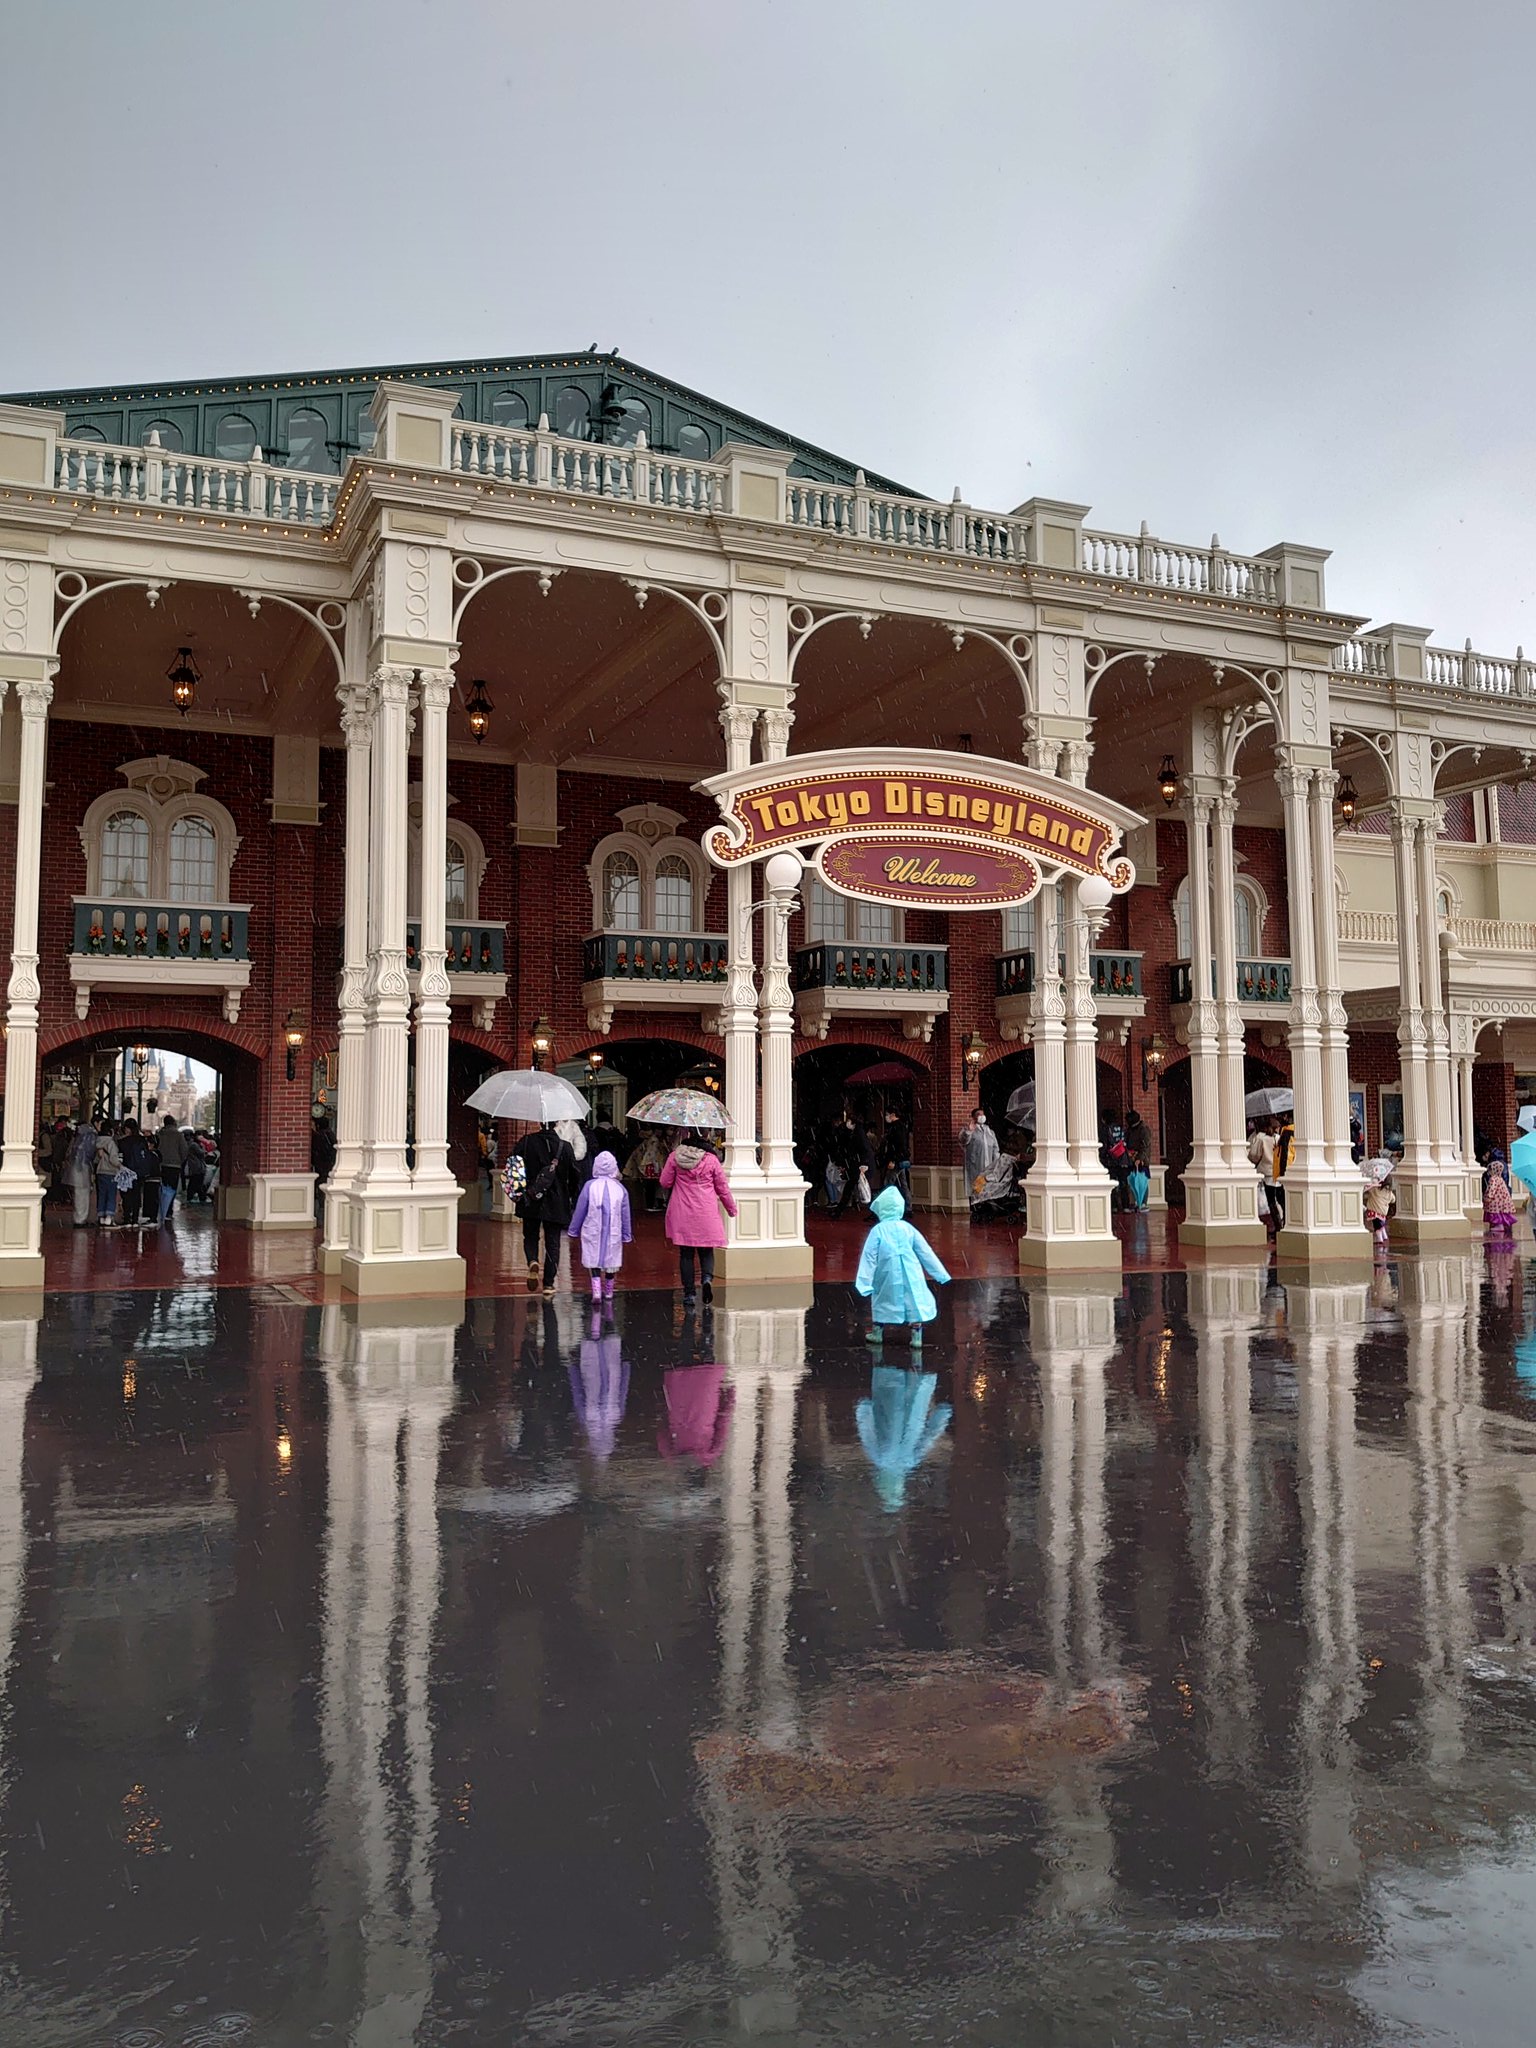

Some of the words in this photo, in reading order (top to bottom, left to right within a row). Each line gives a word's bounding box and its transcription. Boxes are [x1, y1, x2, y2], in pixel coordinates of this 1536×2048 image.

[751, 790, 871, 832] Tokyo
[884, 781, 1094, 857] Disneyland
[883, 856, 977, 888] Welcome
